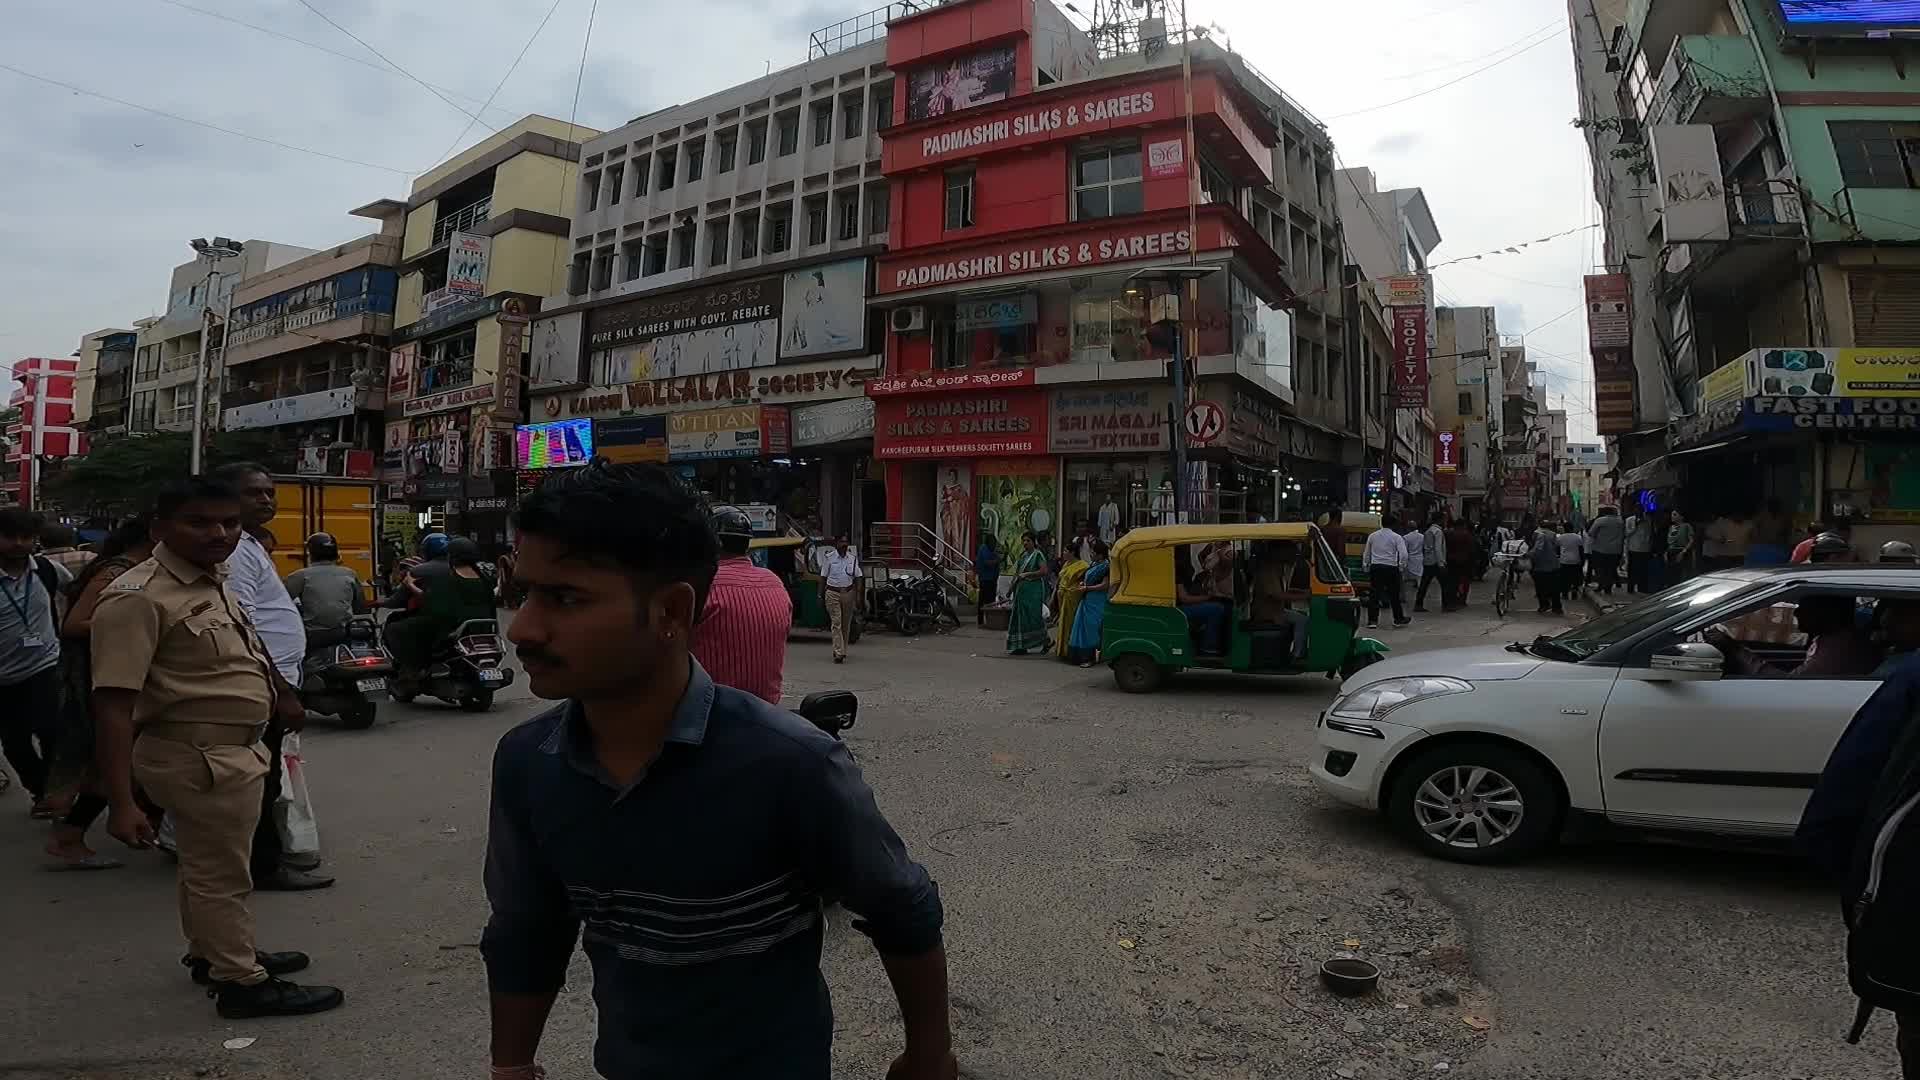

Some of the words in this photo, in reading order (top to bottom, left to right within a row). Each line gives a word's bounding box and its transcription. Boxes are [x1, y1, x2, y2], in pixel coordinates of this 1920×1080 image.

[922, 123, 1009, 155] PADMASHRI
[1012, 109, 1062, 137] SILKS
[1066, 104, 1080, 126] &
[1084, 91, 1155, 124] SAREES
[895, 253, 1004, 288] PADMASHRI
[1008, 244, 1071, 271] SILKS
[1076, 241, 1093, 262] &
[1099, 230, 1191, 260] SAREES
[591, 331, 612, 346] PURE
[616, 328, 634, 340] SILK
[637, 321, 670, 336] SAREES
[673, 315, 697, 330] WITH
[700, 310, 728, 326] GOVT.
[732, 304, 771, 321] REBATE
[1403, 319, 1417, 383] SOCIETY
[758, 369, 843, 396] SOCIETY
[906, 400, 1008, 418] PADMASHRI
[1754, 398, 1841, 414] FAST
[688, 409, 756, 432] TITAN
[887, 417, 937, 438] SILKS
[960, 416, 1031, 433] SAREES
[1058, 415, 1087, 431] SRI
[1794, 414, 1917, 428] CENTER
[931, 444, 945, 453] SILK
[977, 442, 1005, 451] SOCIETY
[1006, 441, 1032, 450] SAREES
[1090, 433, 1160, 448] TEXTILES
